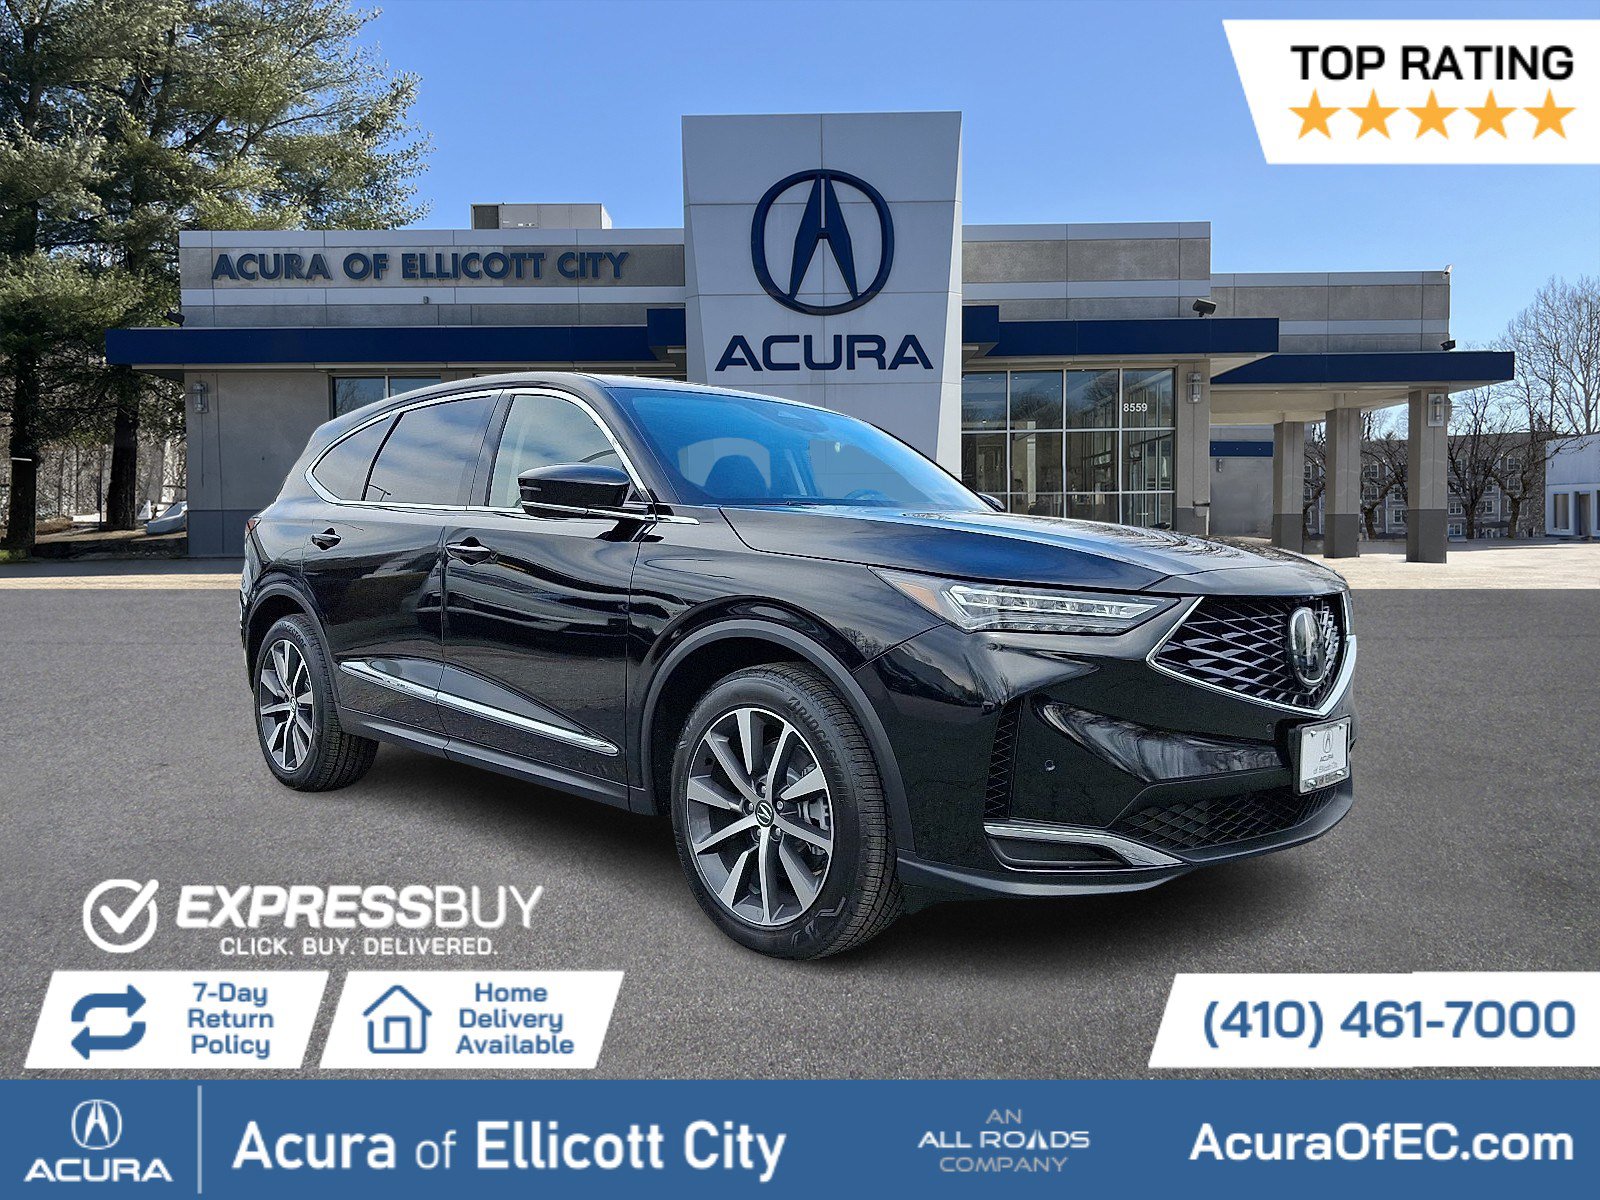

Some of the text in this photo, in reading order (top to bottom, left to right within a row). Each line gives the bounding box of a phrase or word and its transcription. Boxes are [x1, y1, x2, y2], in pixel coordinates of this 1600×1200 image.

[211, 251, 628, 280] ACURA OF ELLICOTT CITY
[715, 335, 933, 371] ACURA
[1123, 402, 1148, 413] 8559
